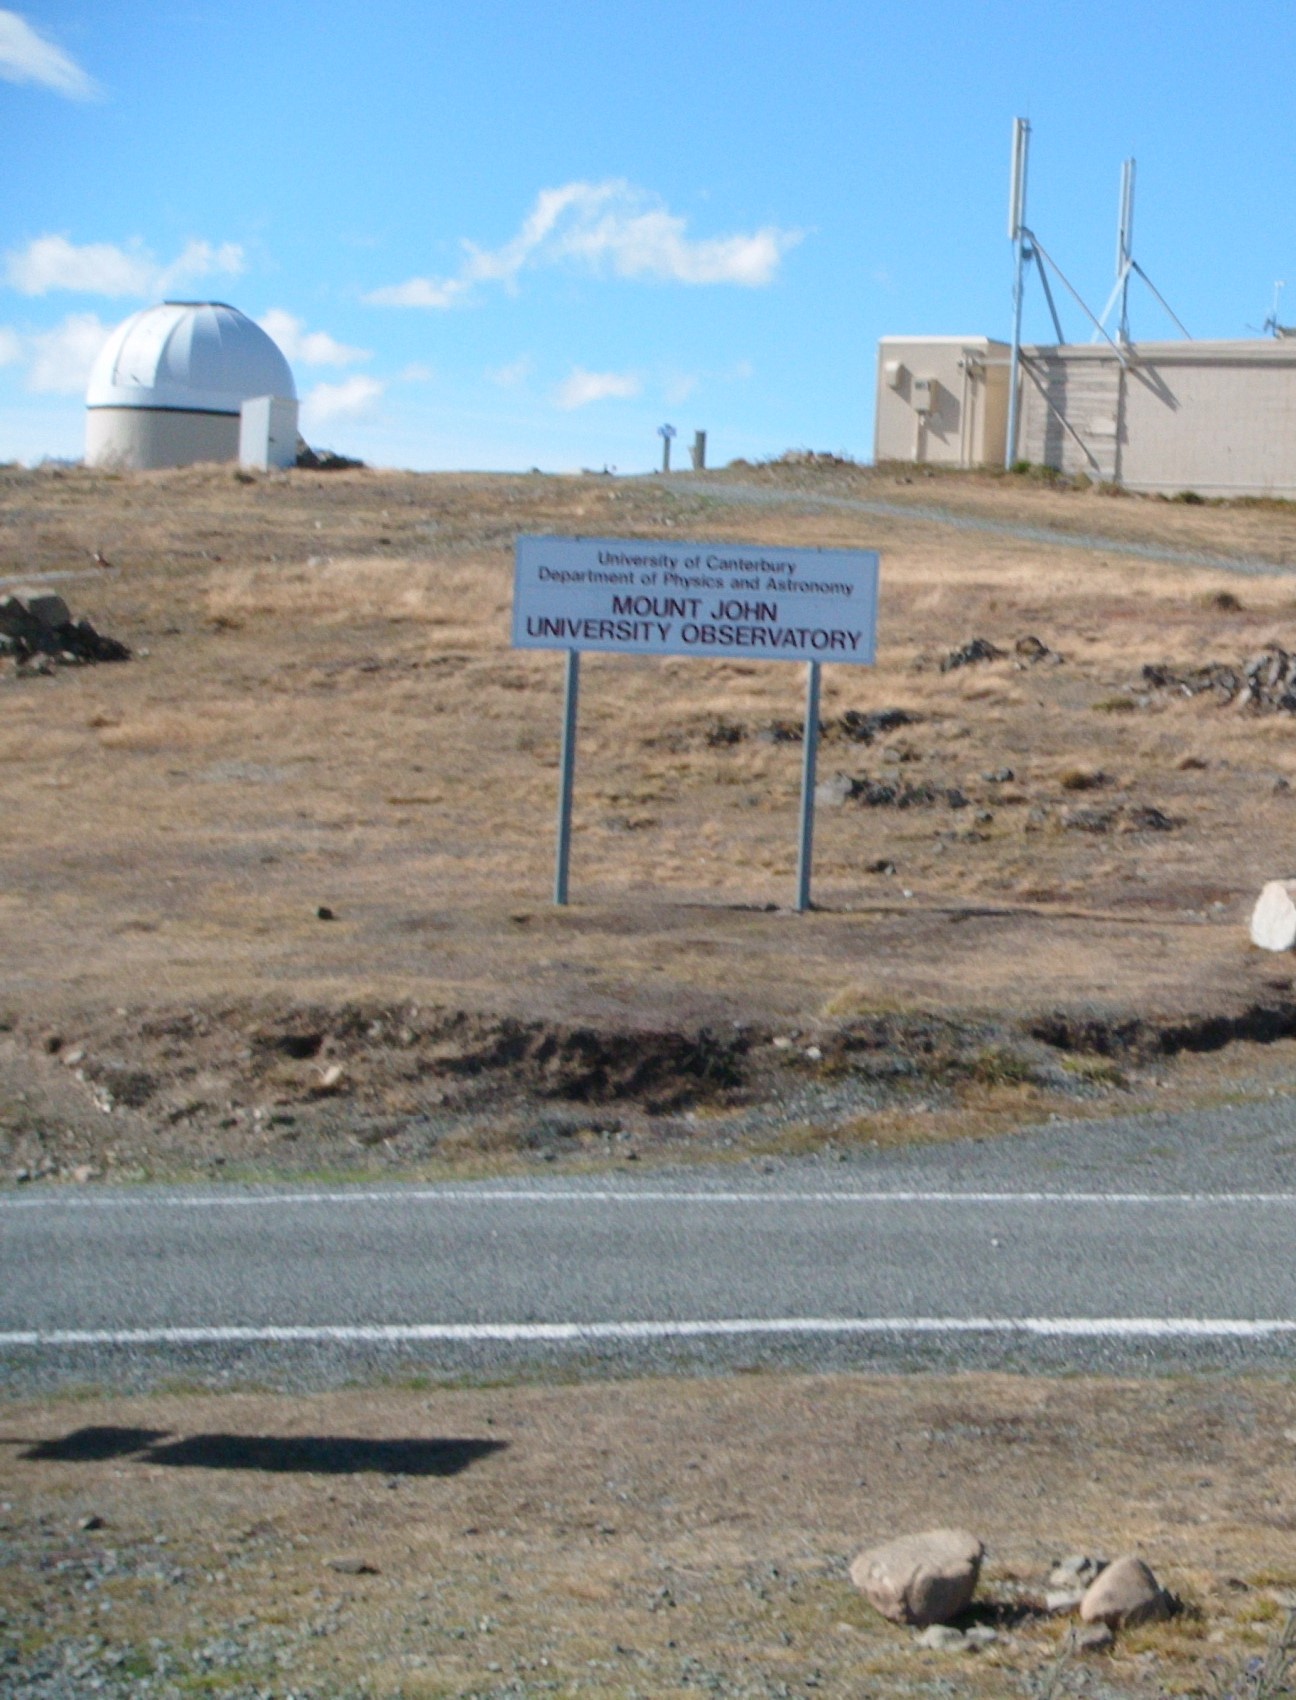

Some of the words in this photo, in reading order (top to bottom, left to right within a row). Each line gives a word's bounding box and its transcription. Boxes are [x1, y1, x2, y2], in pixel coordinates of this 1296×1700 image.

[598, 551, 678, 570] University
[684, 555, 701, 570] of
[707, 556, 797, 575] Canterbury
[538, 566, 634, 586] Department
[641, 570, 658, 586] of
[664, 572, 724, 591] Physics
[730, 575, 760, 591] and
[766, 577, 854, 596] Astronomy
[612, 595, 702, 619] MOUNT
[711, 600, 778, 622] JOHN
[527, 616, 671, 642] UNIVERSITY
[681, 623, 862, 651] OBSERVATORY
